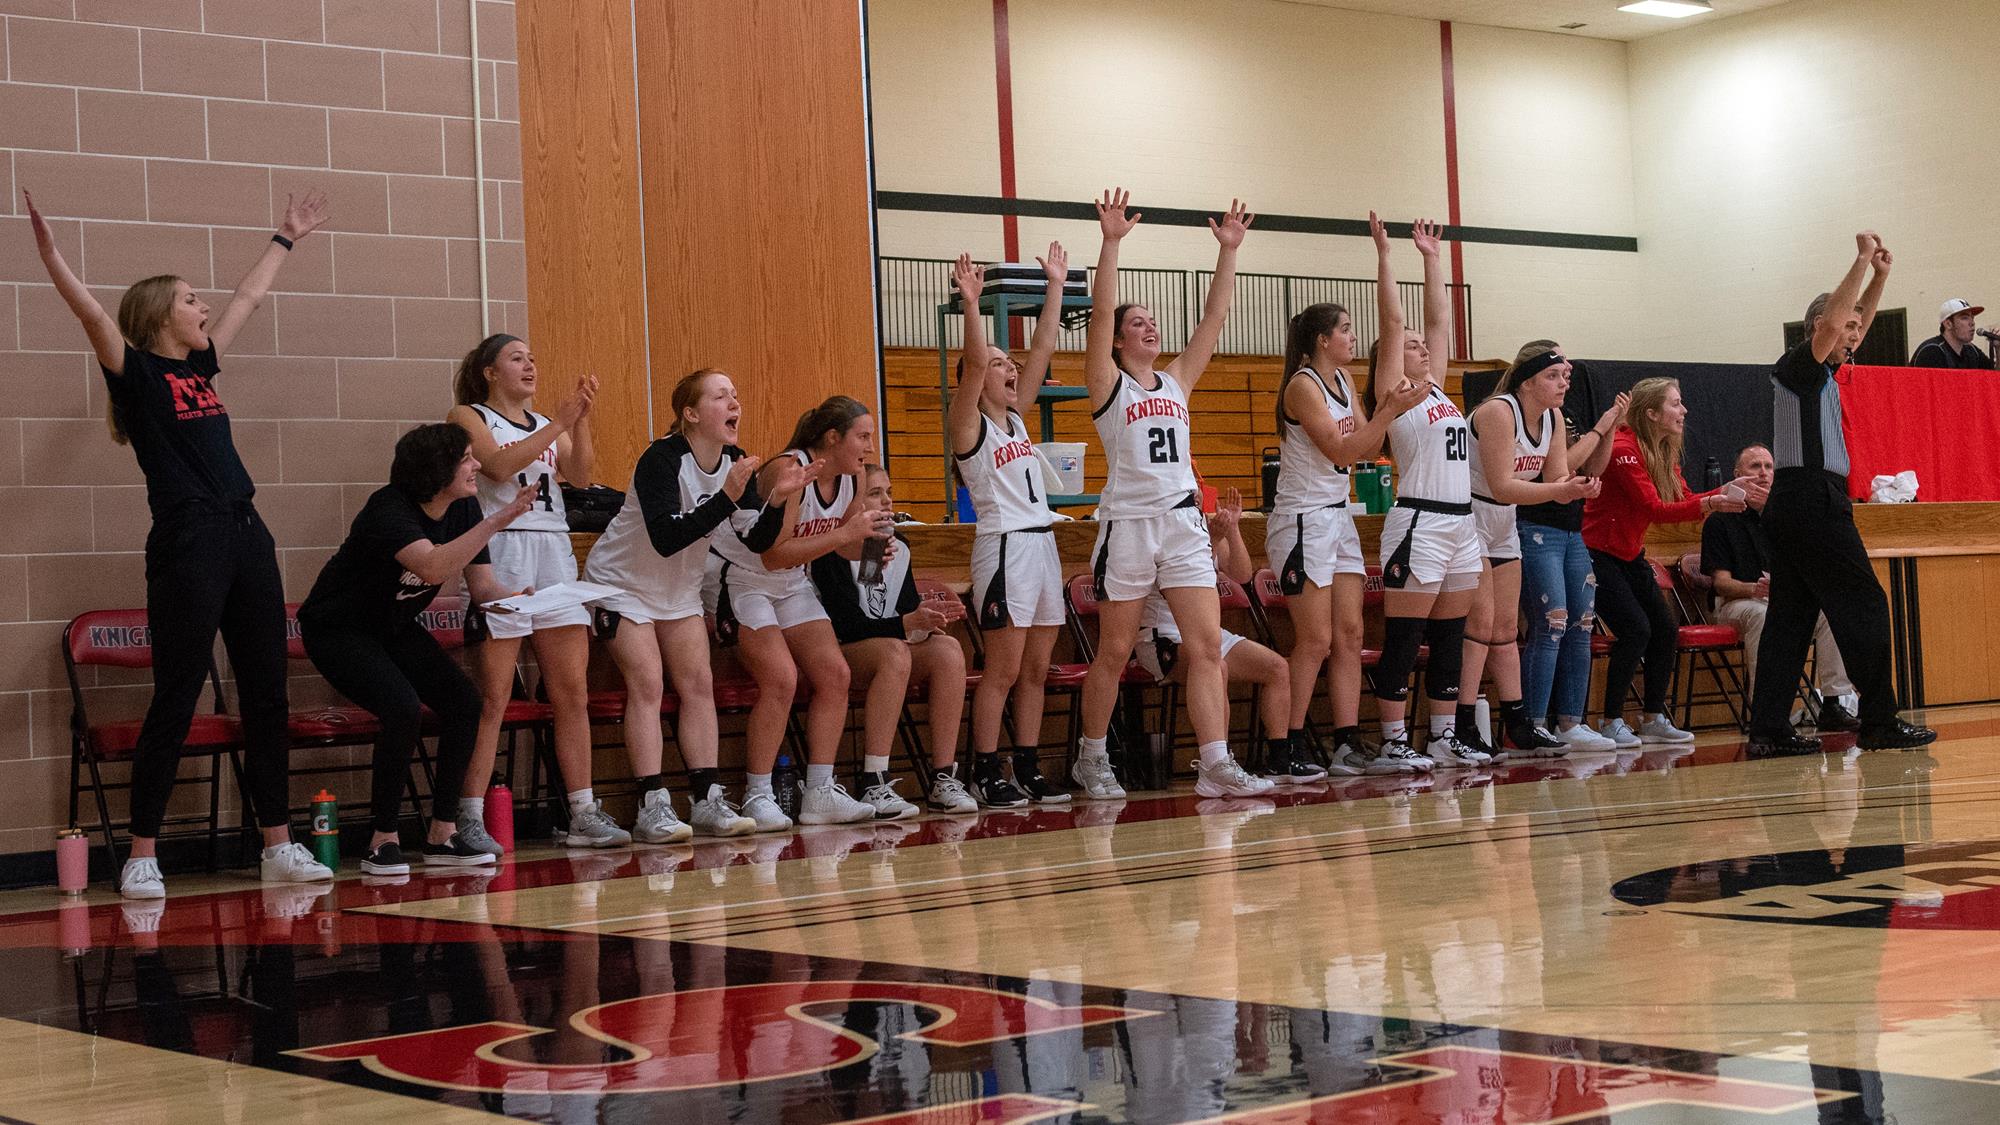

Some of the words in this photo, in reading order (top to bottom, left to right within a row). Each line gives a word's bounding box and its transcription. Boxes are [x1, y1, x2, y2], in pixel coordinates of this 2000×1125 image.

[1125, 398, 1188, 426] KNIGHTS
[1147, 427, 1179, 463] 21
[1445, 426, 1467, 461] 20
[1615, 455, 1638, 466] MLC
[1024, 467, 1039, 504] 1
